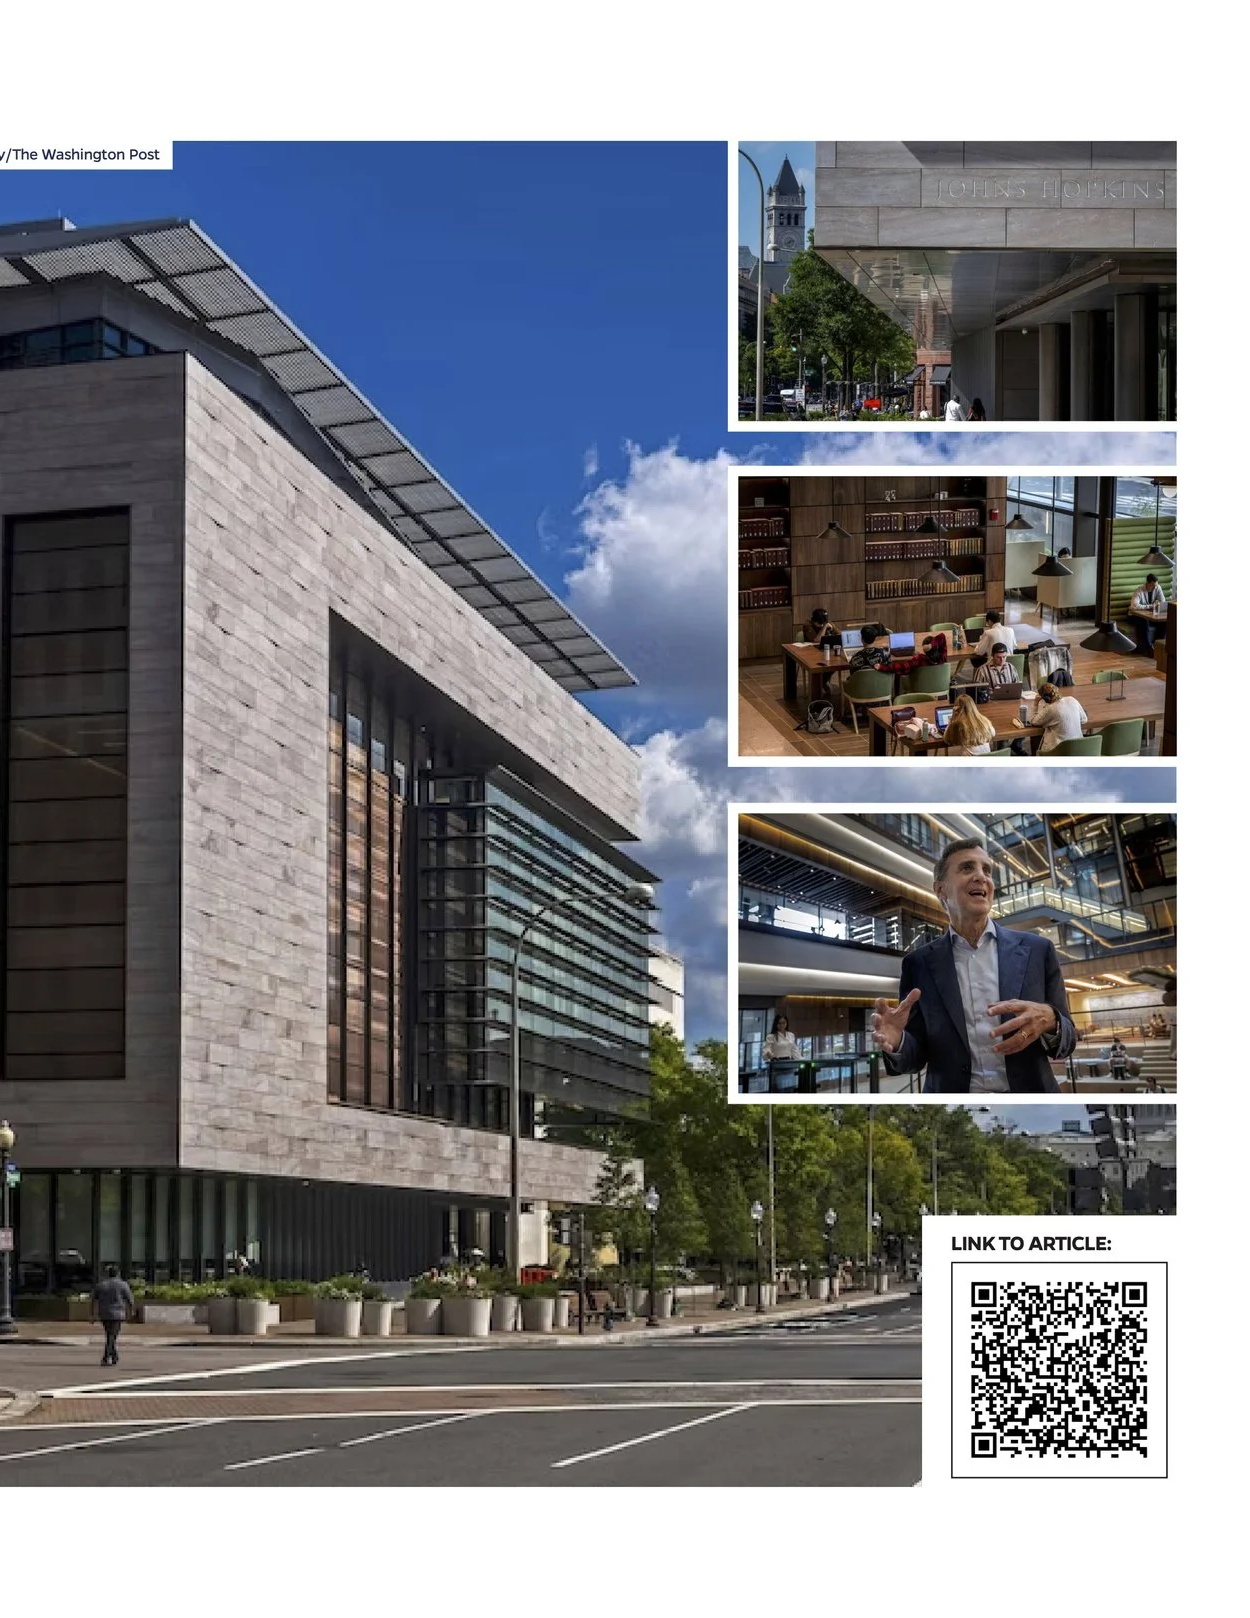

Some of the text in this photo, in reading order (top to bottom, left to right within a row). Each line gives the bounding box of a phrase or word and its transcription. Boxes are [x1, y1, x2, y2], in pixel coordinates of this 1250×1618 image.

[936, 180, 1164, 198] JOHNS HOPKINS
[951, 1236, 1111, 1250] LINK TO ARTICLE:
